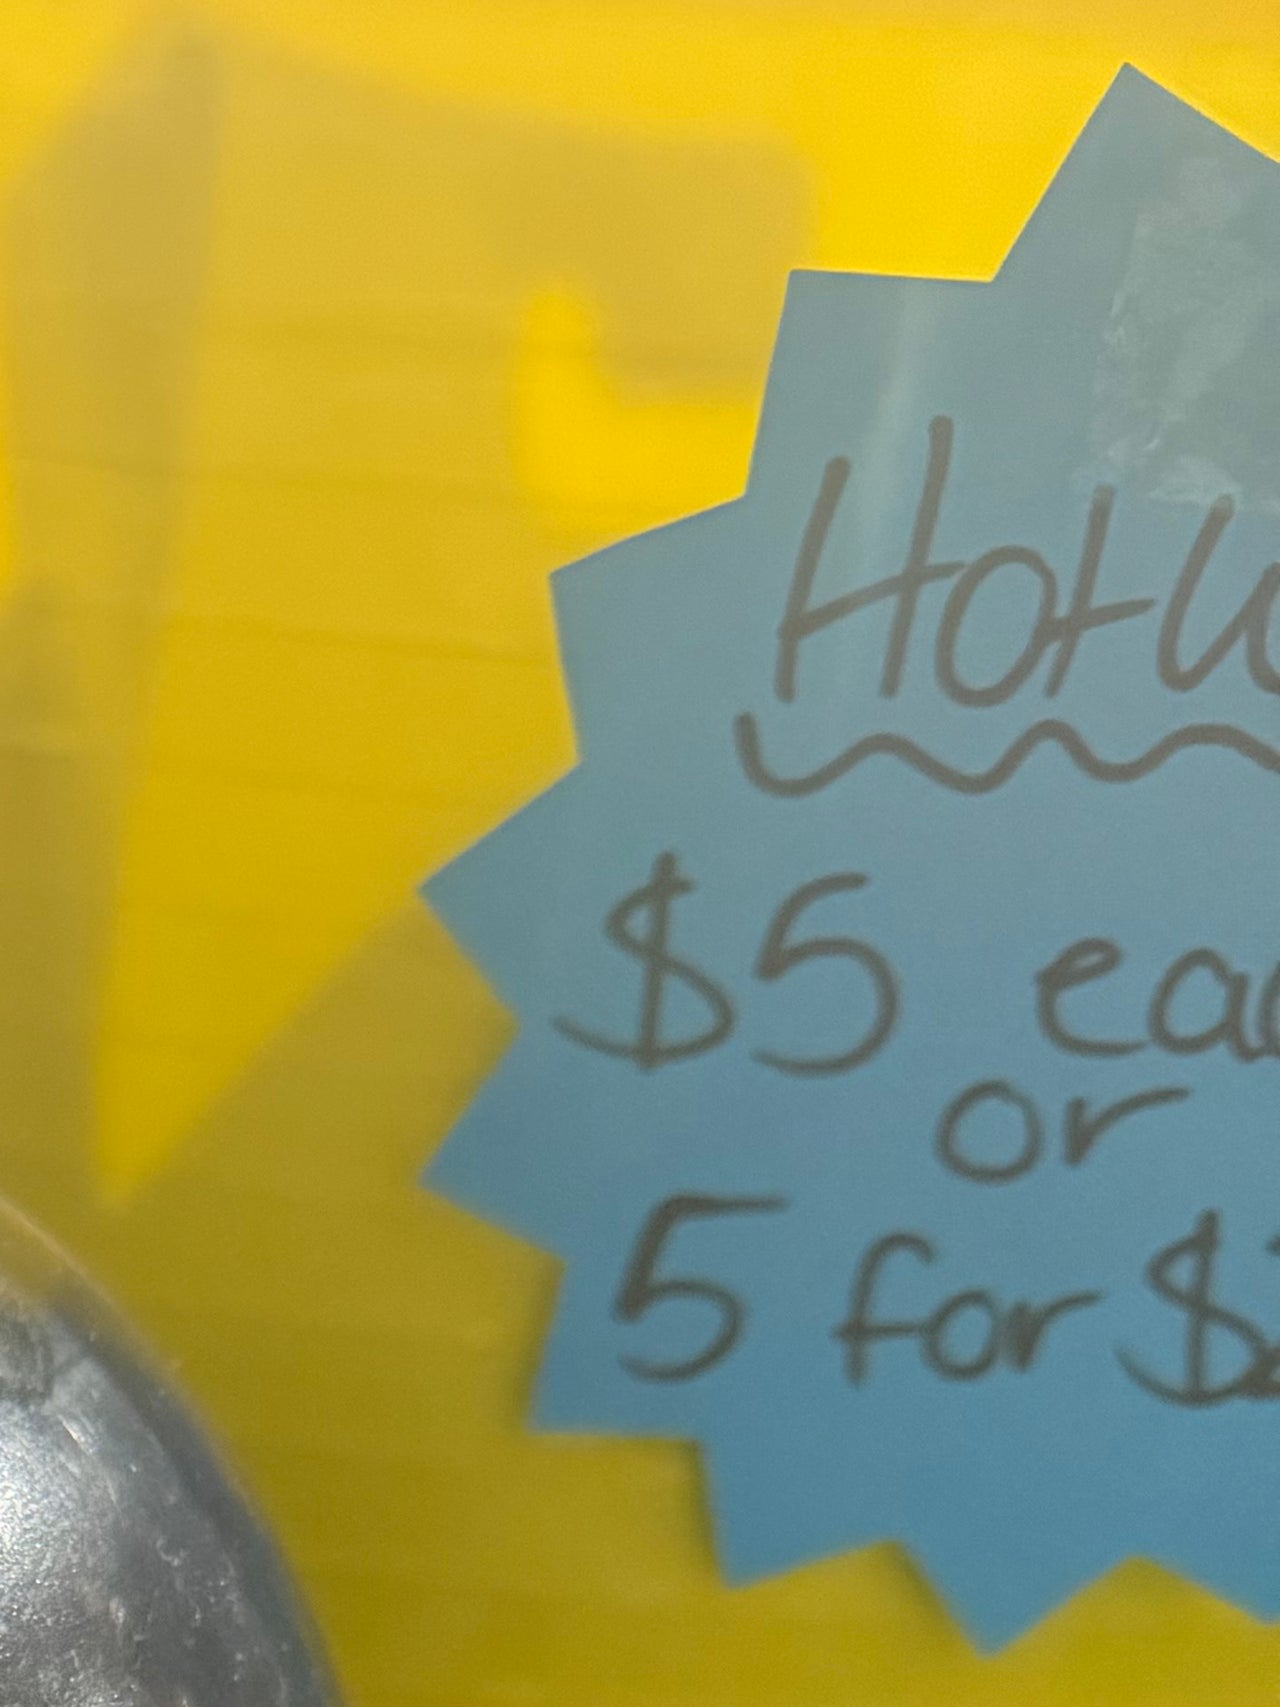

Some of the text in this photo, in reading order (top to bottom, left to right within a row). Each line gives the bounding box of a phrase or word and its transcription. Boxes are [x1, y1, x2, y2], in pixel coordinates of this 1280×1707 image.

[550, 850, 1280, 1077] $5 ea
[934, 1078, 1192, 1186] or
[611, 1192, 793, 1384] 5
[830, 1230, 1107, 1391] for
